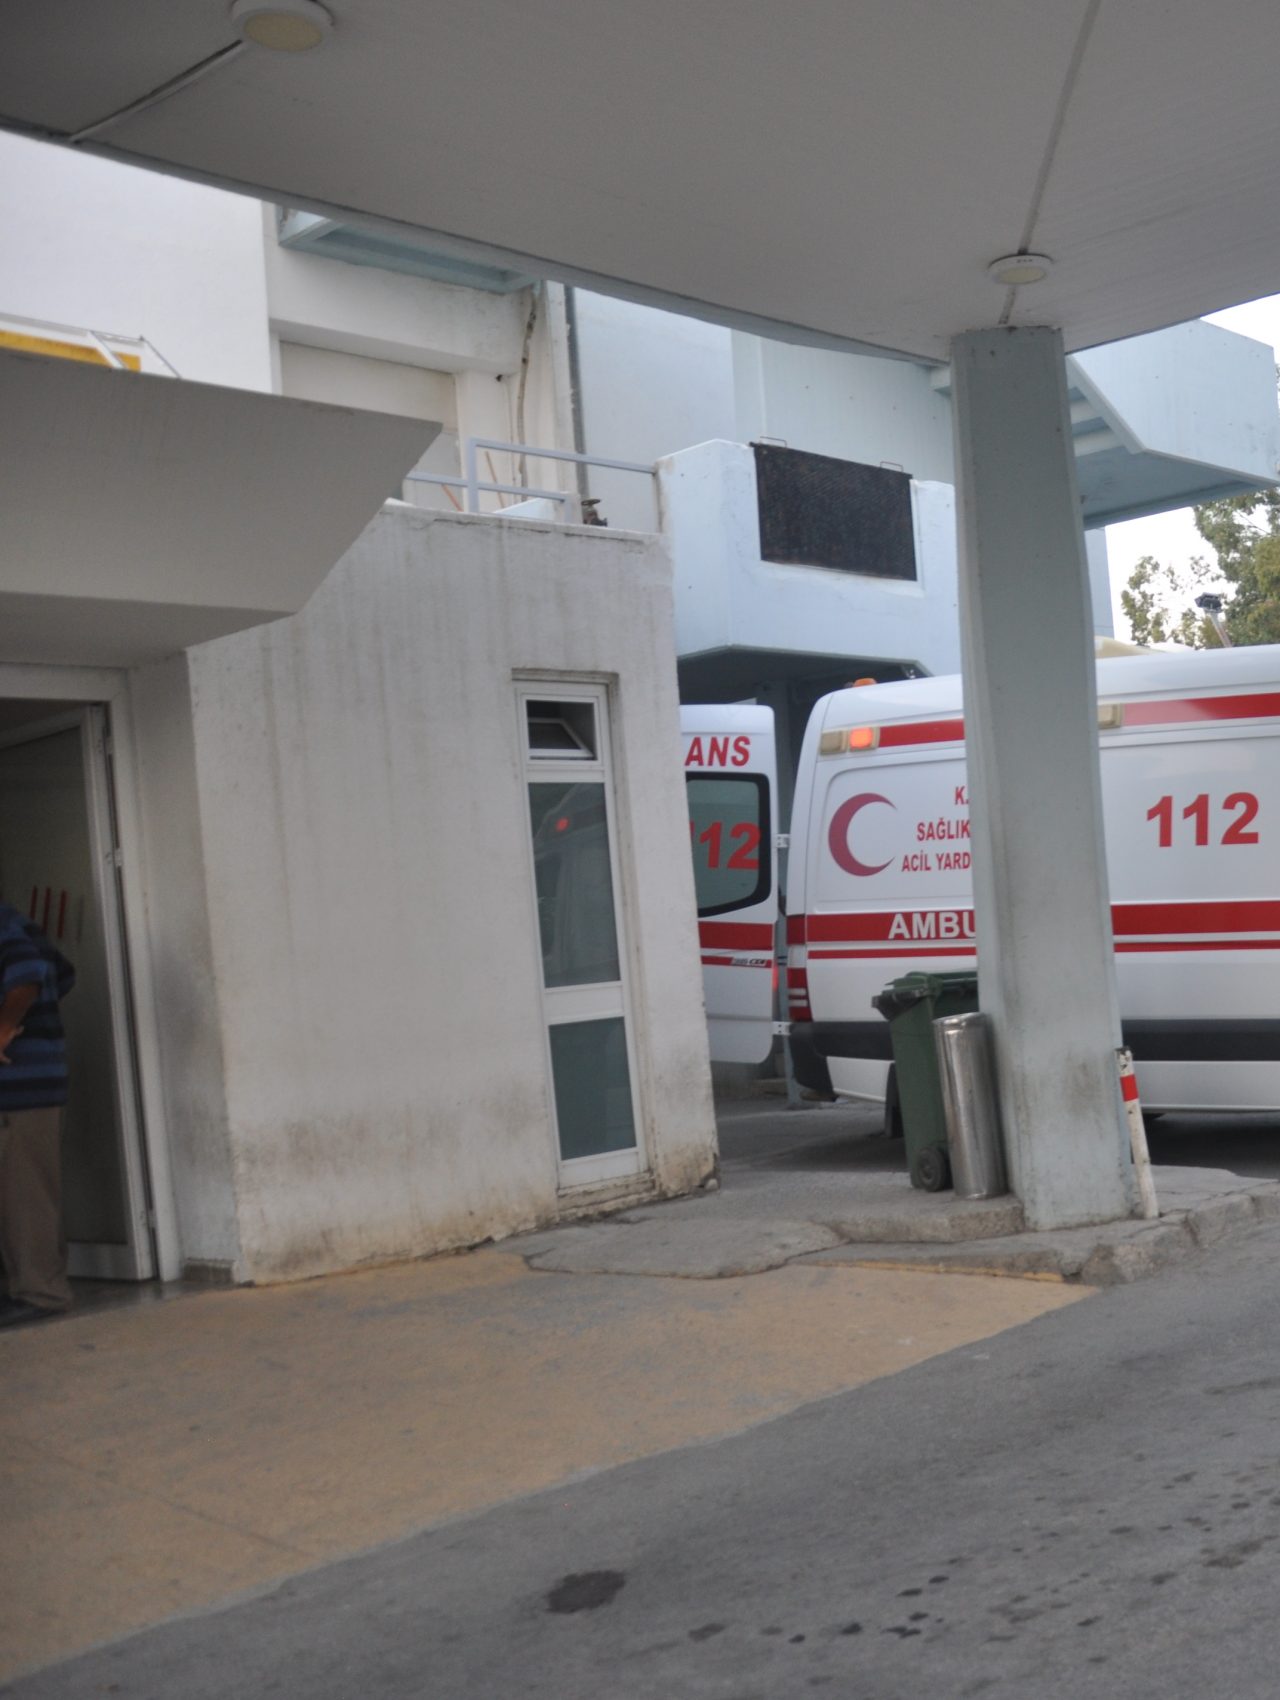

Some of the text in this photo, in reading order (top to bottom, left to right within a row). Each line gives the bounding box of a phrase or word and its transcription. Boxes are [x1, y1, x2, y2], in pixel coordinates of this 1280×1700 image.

[684, 735, 751, 767] ANS
[916, 817, 971, 841] SAĞLIK
[1146, 791, 1260, 848] 112
[690, 820, 761, 870] 12
[901, 850, 971, 872] ACİL YARD
